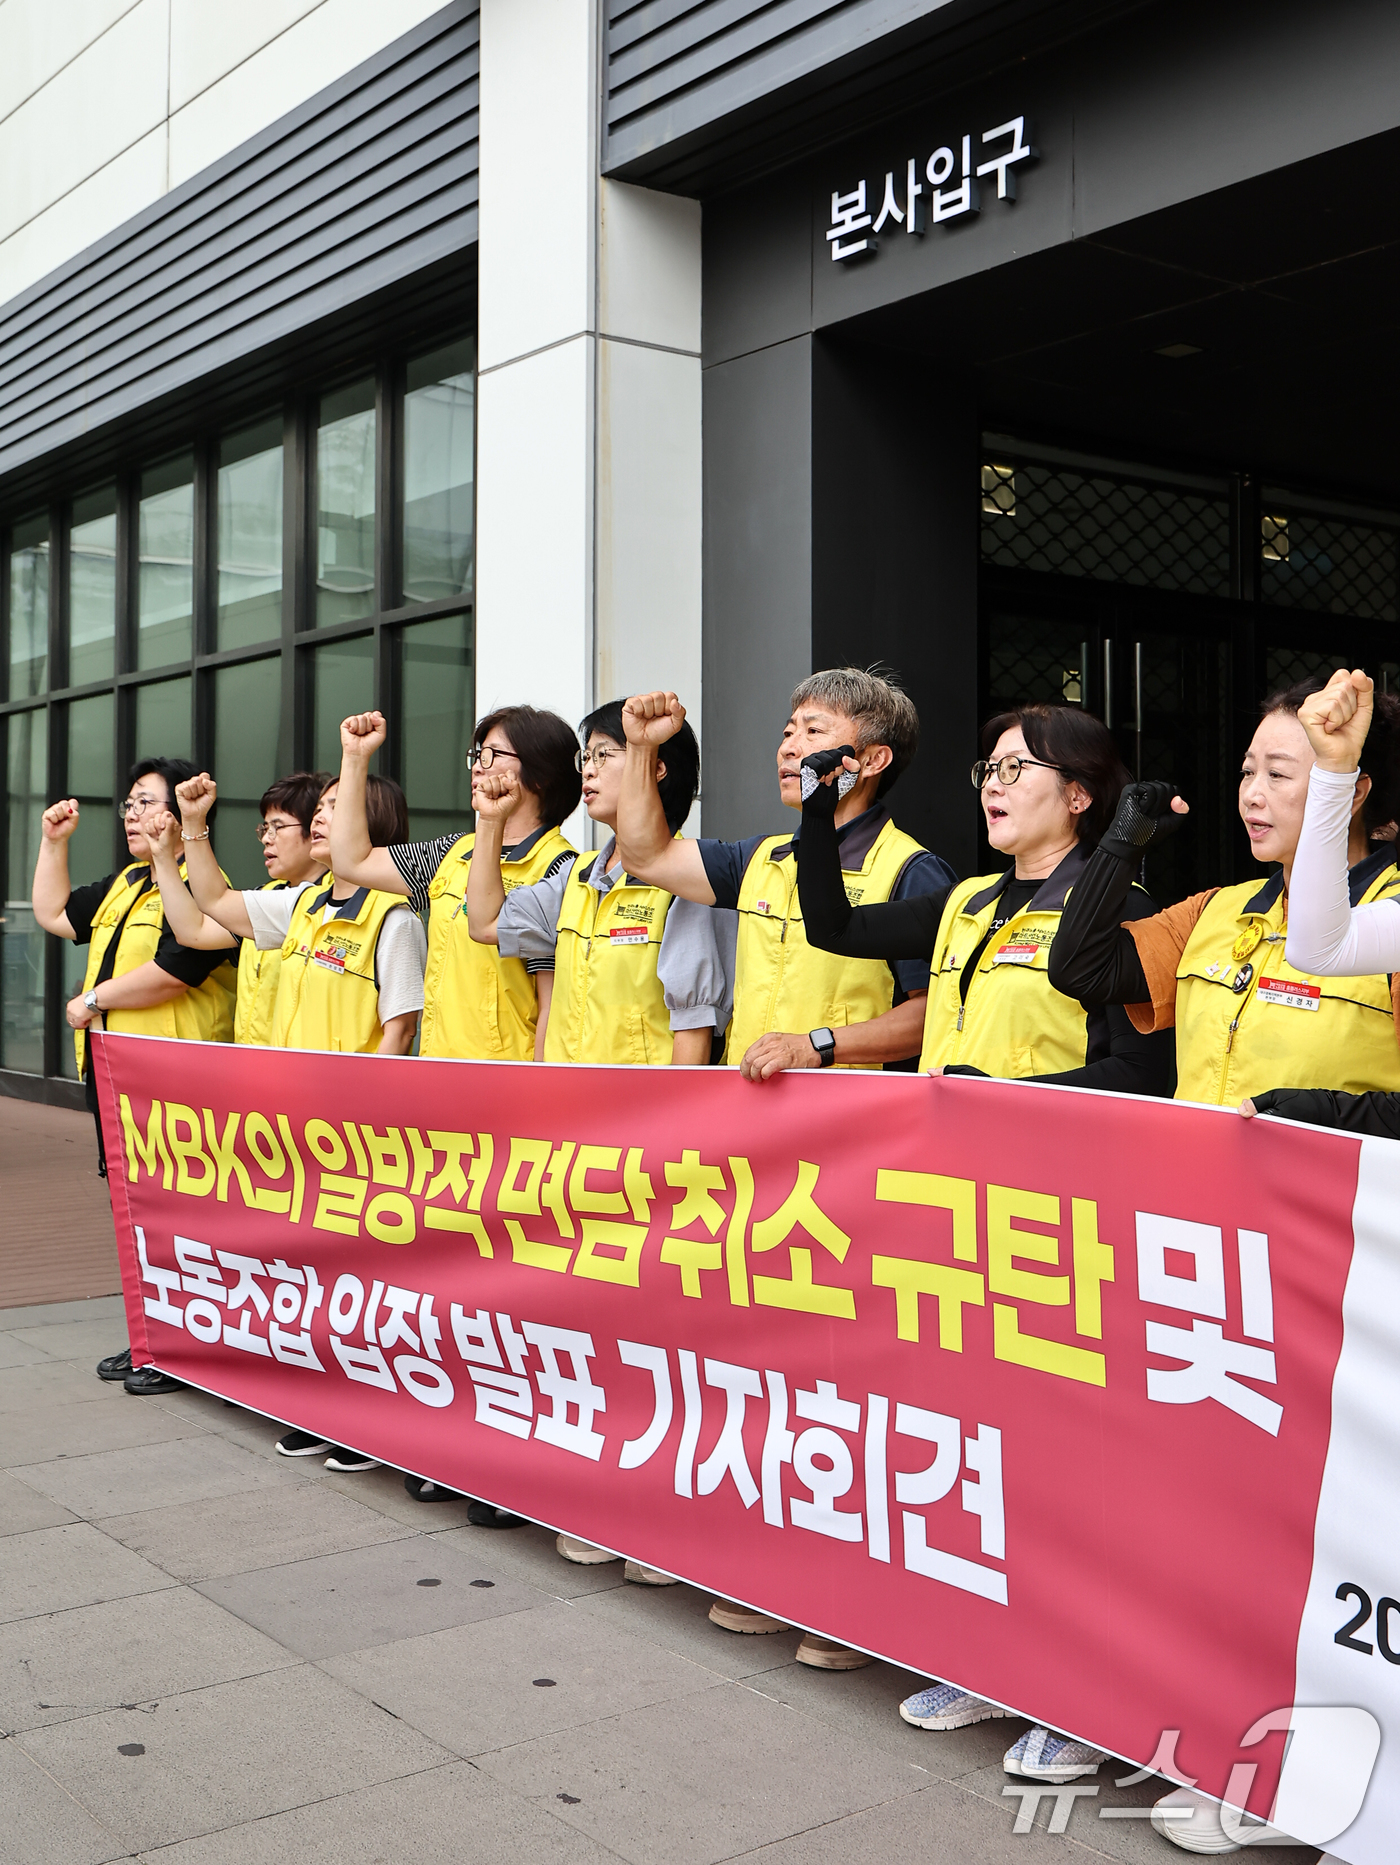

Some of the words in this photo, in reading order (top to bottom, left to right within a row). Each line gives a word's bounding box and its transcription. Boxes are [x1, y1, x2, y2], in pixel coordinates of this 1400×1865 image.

[826, 115, 1031, 261] 본사입구
[119, 1093, 305, 1223] MBK의
[304, 1118, 494, 1260] 일방적
[497, 1137, 656, 1288] 면담
[660, 1149, 857, 1320] 취소
[872, 1168, 1115, 1388] 규탄
[1135, 1210, 1284, 1438] 및
[134, 1225, 326, 1373] 노동조합
[328, 1273, 455, 1408] 입장
[450, 1302, 607, 1462] 발표
[616, 1339, 1009, 1607] 기자회견
